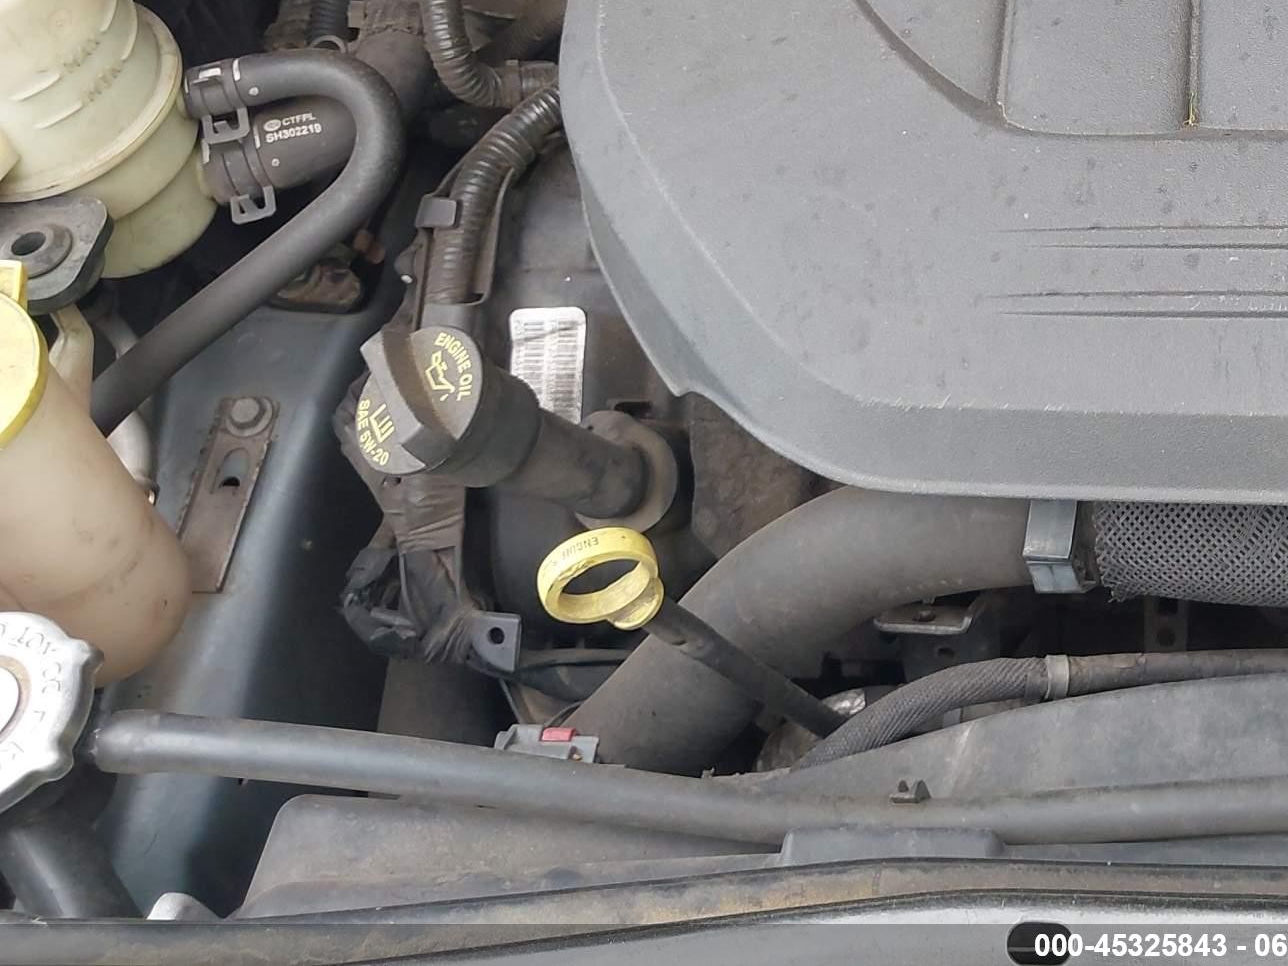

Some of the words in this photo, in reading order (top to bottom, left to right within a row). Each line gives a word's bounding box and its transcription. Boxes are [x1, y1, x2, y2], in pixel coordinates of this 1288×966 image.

[434, 331, 472, 374] ENGINE
[456, 373, 473, 402] OIL
[357, 399, 371, 430] SAE
[359, 431, 390, 466] 5W-20
